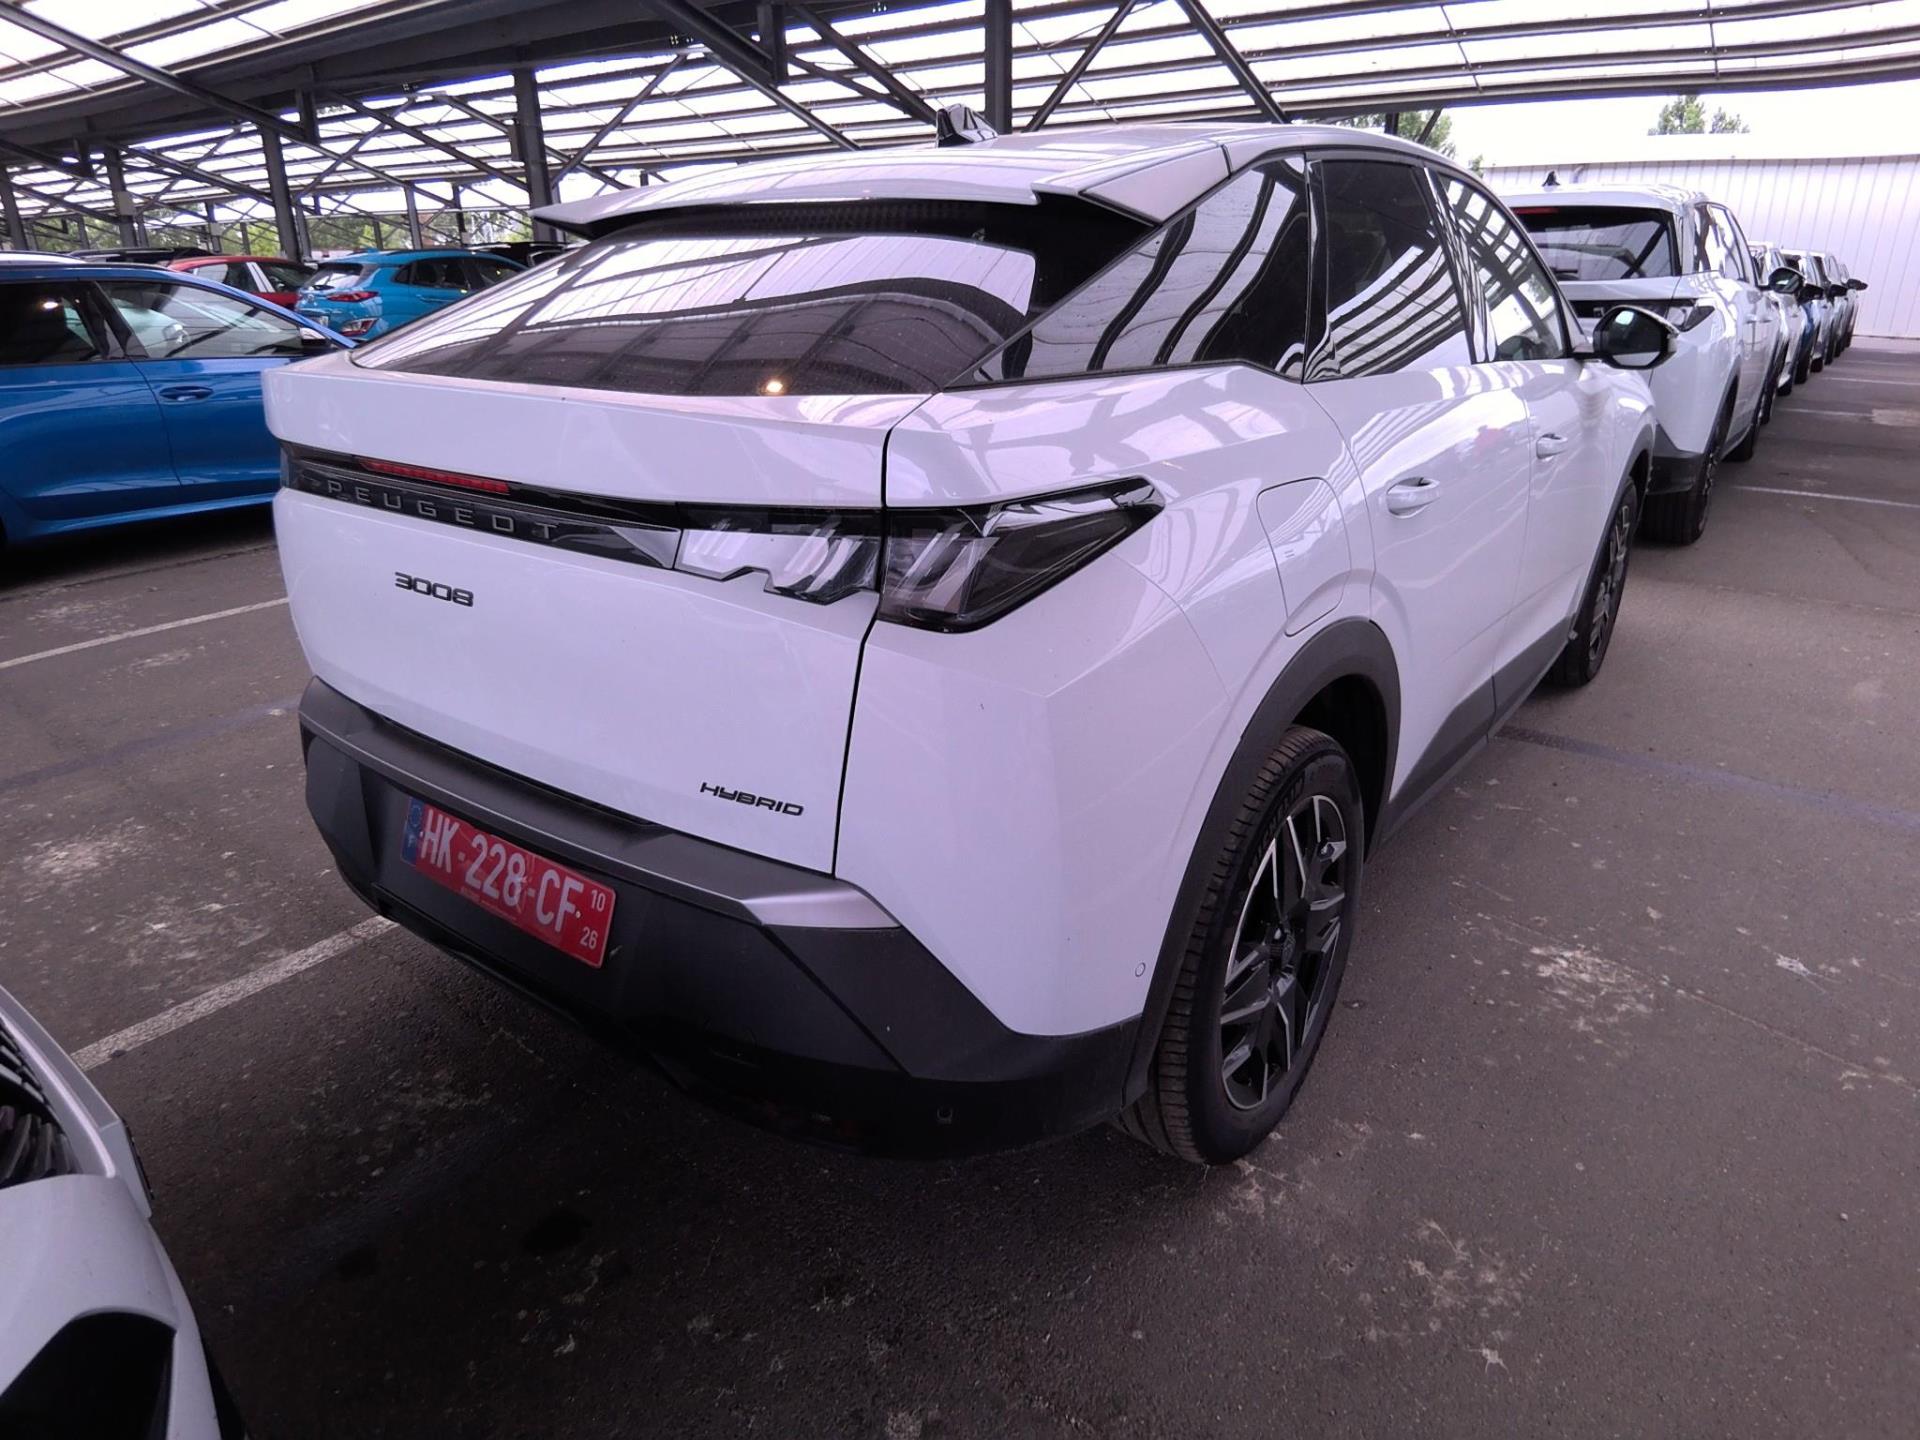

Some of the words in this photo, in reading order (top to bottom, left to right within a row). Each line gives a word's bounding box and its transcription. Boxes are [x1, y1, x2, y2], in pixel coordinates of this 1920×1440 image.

[327, 480, 561, 539] PEUGEOT
[395, 571, 474, 607] 3008
[700, 782, 804, 816] HYBRID
[590, 889, 606, 912] 10
[580, 926, 598, 950] 26
